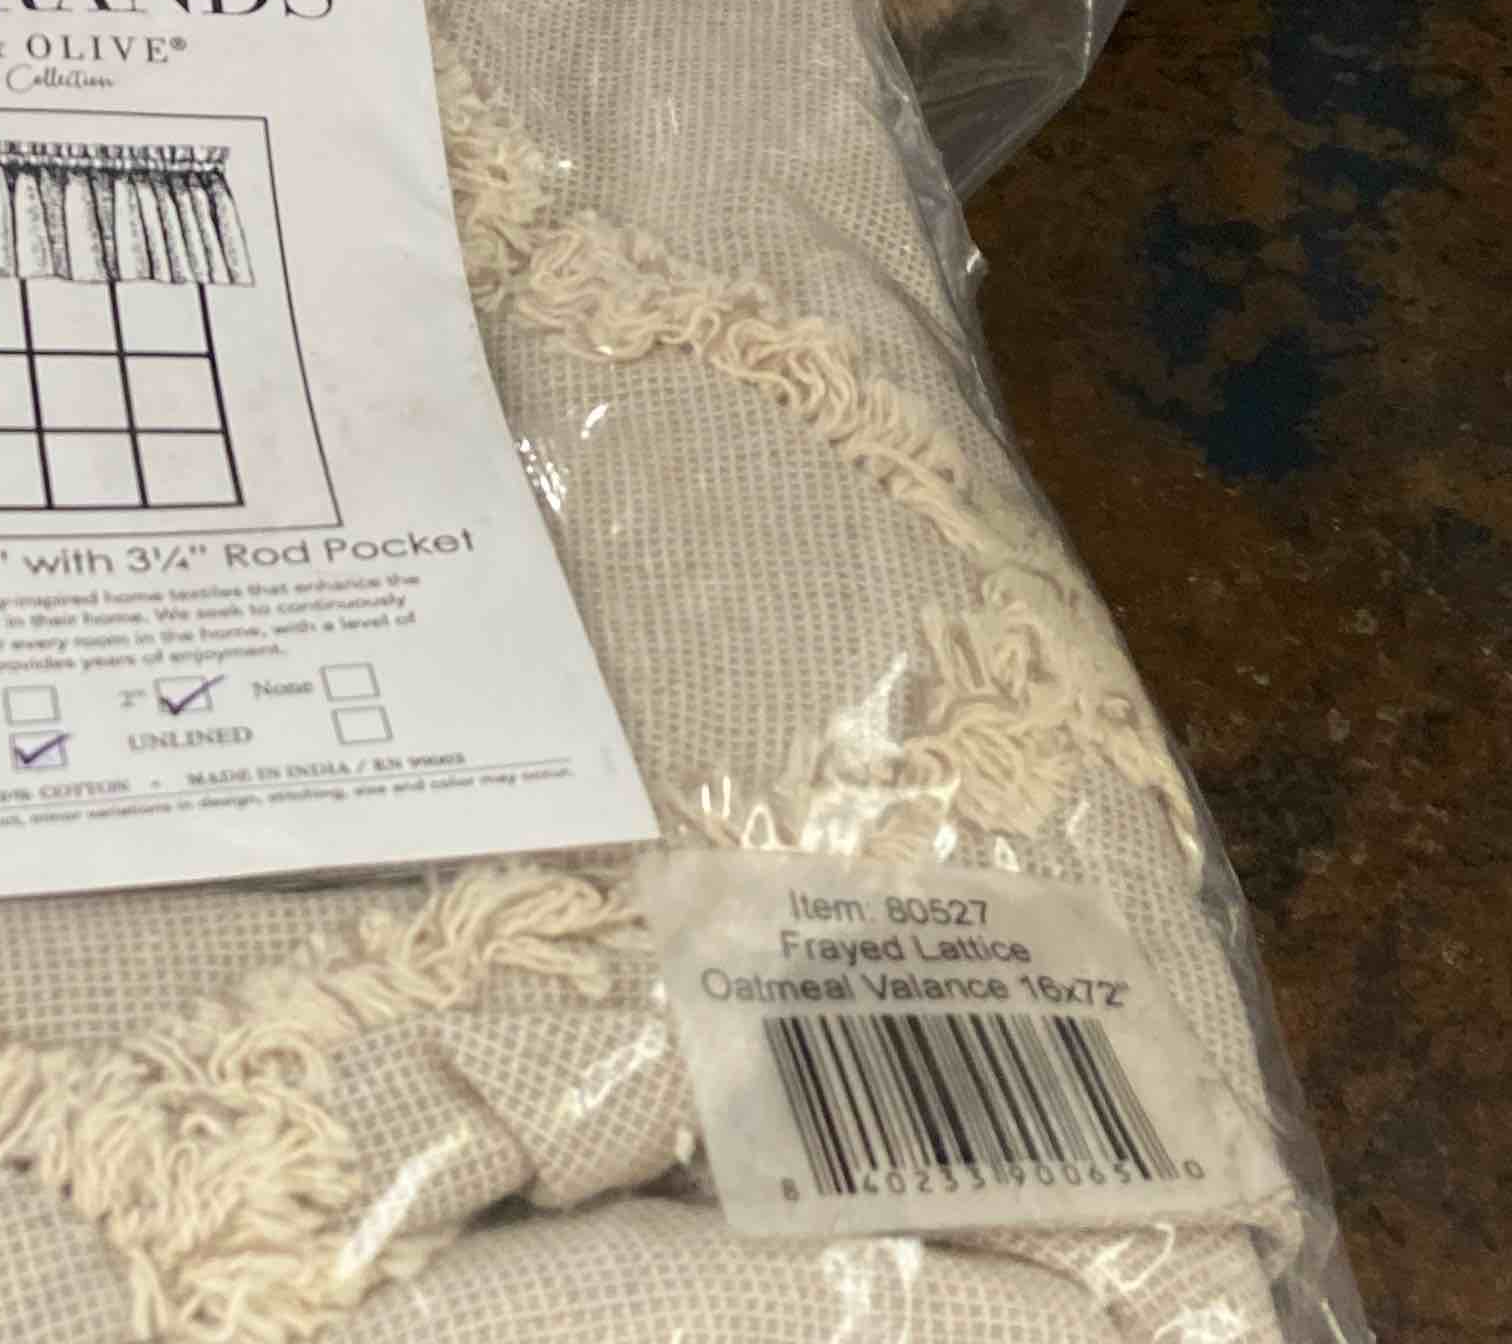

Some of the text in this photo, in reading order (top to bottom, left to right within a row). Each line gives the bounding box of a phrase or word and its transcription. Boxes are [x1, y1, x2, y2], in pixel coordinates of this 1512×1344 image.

[5, 63, 116, 94] Collection
[23, 545, 114, 576] with
[225, 540, 311, 568] Rod
[324, 528, 475, 560] Pocket
[104, 588, 163, 604] home
[169, 584, 242, 601] textiles
[248, 582, 288, 596] that
[294, 577, 381, 593] enhance
[386, 572, 420, 587] the
[6, 614, 25, 627] in
[29, 611, 77, 627] their
[82, 610, 149, 625] home.
[154, 606, 190, 622] We
[196, 604, 244, 619] seek
[250, 602, 270, 616] to
[277, 594, 406, 614] continuously
[11, 637, 67, 655] every
[74, 634, 130, 648] room
[135, 630, 155, 645] in
[159, 628, 193, 643] the
[273, 620, 316, 636] with
[340, 614, 389, 631] level
[395, 610, 418, 627] of
[82, 654, 136, 672] years
[142, 650, 163, 665] of
[169, 643, 287, 665] enjoyment.
[252, 678, 315, 700] None
[127, 725, 254, 753] UNLINED
[39, 779, 130, 800] COTTON
[186, 767, 251, 786] MADE
[256, 764, 281, 781] IN
[286, 759, 351, 778] INDIA
[176, 800, 194, 813] in
[354, 784, 387, 798] size
[392, 777, 426, 793] and
[431, 775, 474, 790] color
[479, 772, 516, 788] may
[887, 896, 990, 925] 80527
[780, 930, 1032, 966] Frayed Lattice
[701, 967, 853, 1002] Oatmeal
[860, 971, 1009, 1001] Valance
